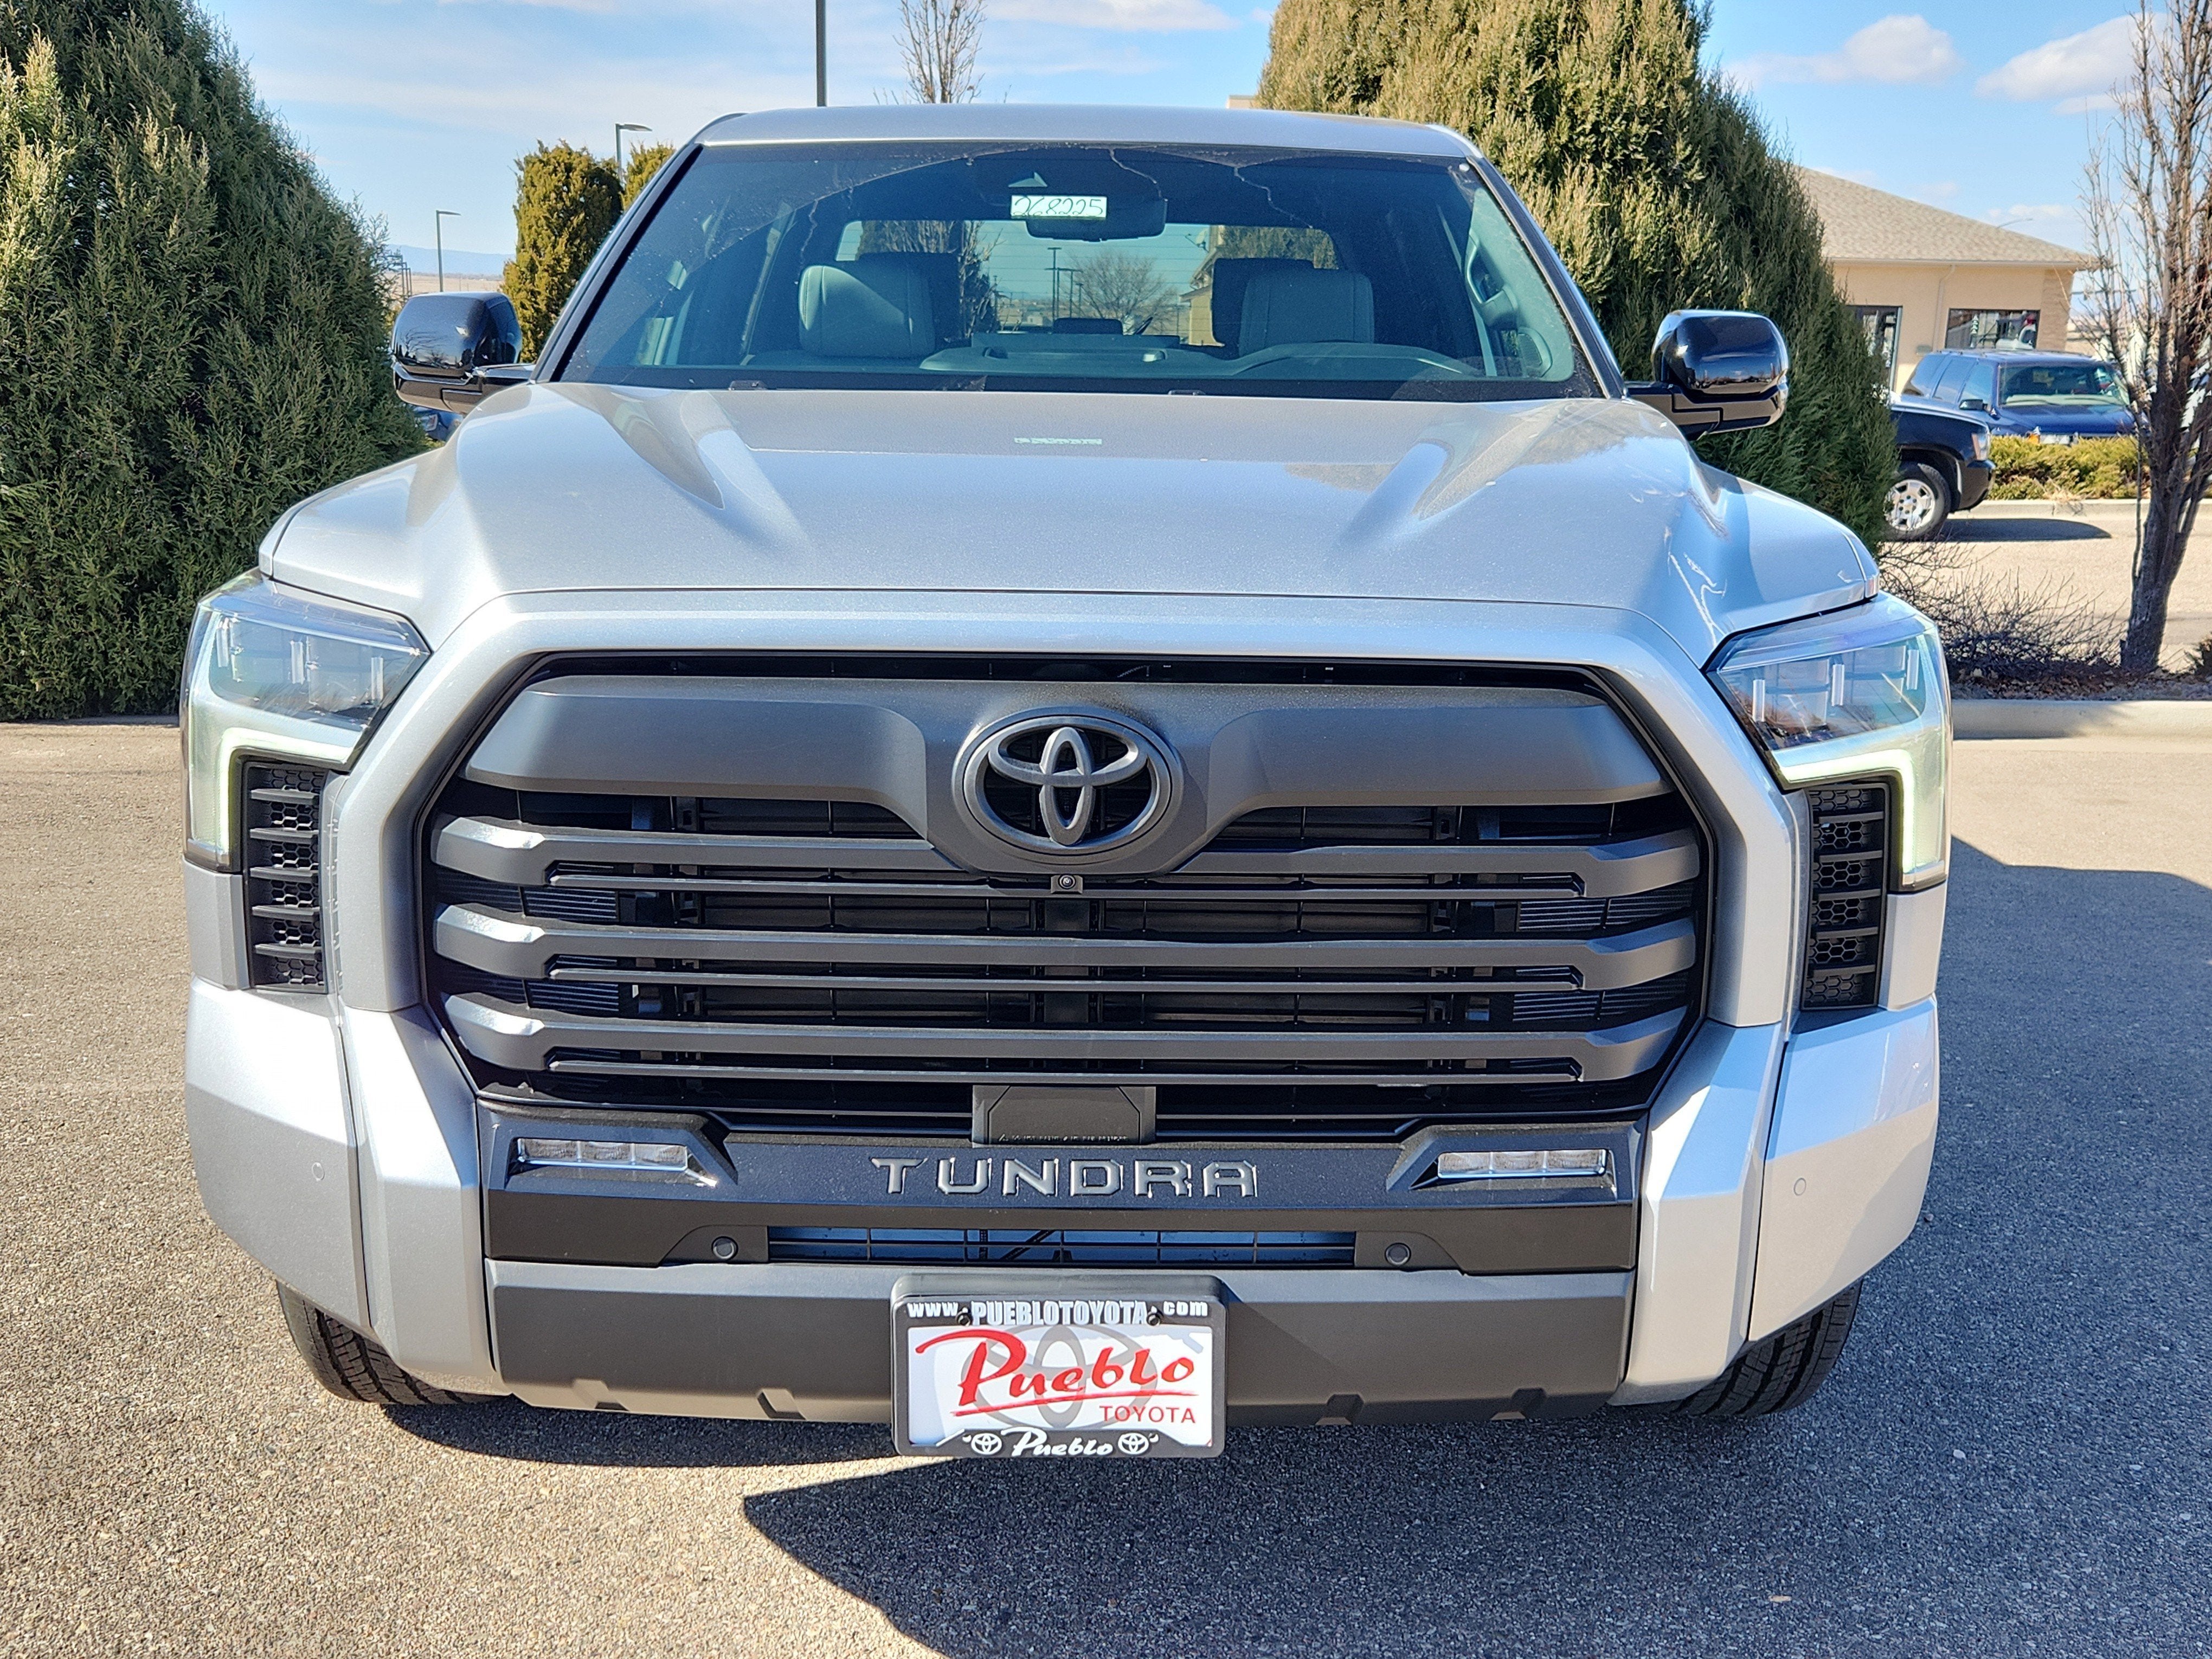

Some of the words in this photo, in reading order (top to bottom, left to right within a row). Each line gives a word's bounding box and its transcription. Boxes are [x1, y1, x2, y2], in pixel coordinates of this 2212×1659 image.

[1013, 196, 1103, 217] 268225
[871, 1157, 1258, 1197] TUNDRA
[915, 1329, 1194, 1406] Pueblo
[1099, 1405, 1196, 1424] TOYOTA
[1000, 1426, 1113, 1456] Pueblo
